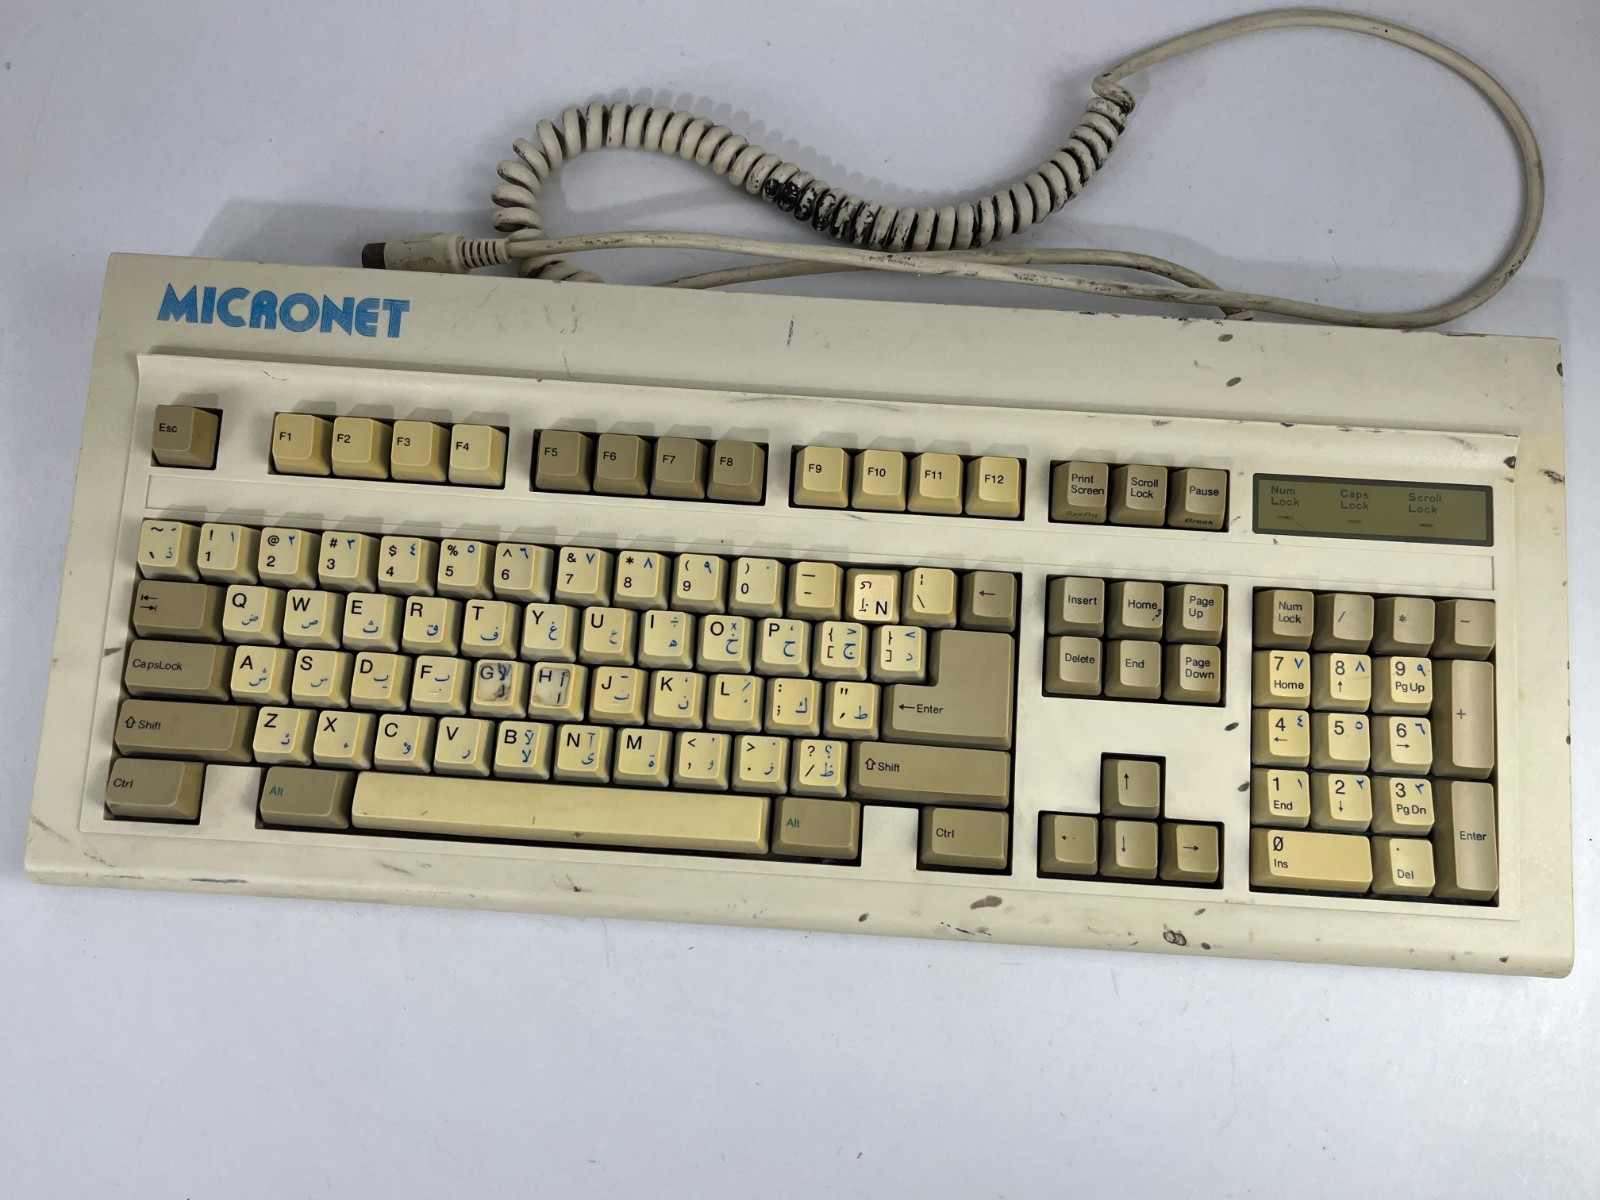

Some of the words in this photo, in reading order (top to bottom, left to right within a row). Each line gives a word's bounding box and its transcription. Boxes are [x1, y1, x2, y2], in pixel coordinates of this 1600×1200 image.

[157, 282, 410, 338] MICRONET
[159, 422, 177, 434] Esc
[279, 431, 292, 442] F1
[336, 433, 351, 444] F2
[397, 436, 410, 447] F3
[456, 441, 469, 451] F4
[544, 447, 558, 457] F5
[603, 451, 617, 461] F6
[662, 455, 676, 464] F7
[720, 457, 733, 467] F8
[808, 464, 822, 473] F9
[868, 467, 886, 477] F10
[925, 470, 942, 480] F11
[984, 474, 1004, 484] F12
[1071, 474, 1094, 484] Print
[1131, 477, 1158, 488] Scroll
[1071, 485, 1104, 495] Screen
[1131, 488, 1153, 499] Lock
[1189, 486, 1219, 496] Pause
[1271, 486, 1295, 495] Num
[1340, 489, 1369, 500] Caps
[1271, 496, 1299, 506] Lock
[1409, 493, 1442, 503] Scroll
[1341, 501, 1369, 510] Lock
[1409, 504, 1437, 514] Lock
[209, 530, 213, 540] !
[267, 535, 280, 546] @
[329, 538, 338, 548] #
[205, 551, 210, 561] 1
[388, 545, 397, 557] $
[447, 545, 458, 557] %
[266, 556, 276, 567] 2
[567, 553, 576, 563] &
[326, 559, 335, 570] 3
[386, 567, 394, 577] 4
[445, 566, 454, 577] 5
[501, 569, 510, 580] 6
[566, 574, 574, 584] 7
[623, 577, 632, 588] 8
[683, 581, 691, 591] 9
[741, 583, 749, 594] 0
[232, 593, 247, 608] Q
[292, 598, 311, 612] W
[1068, 594, 1097, 605] Insert
[1128, 600, 1158, 610] Home
[1190, 595, 1214, 607] Page
[351, 600, 363, 615] E
[410, 602, 423, 617] R
[1278, 600, 1303, 611] Num
[472, 606, 484, 620] T
[532, 610, 544, 624] Y
[1189, 608, 1203, 619] Up
[1278, 613, 1301, 624] Lock
[242, 614, 259, 625] ض
[301, 619, 319, 629] ص
[591, 613, 604, 628] U
[651, 615, 654, 629] I
[427, 624, 439, 636] ق
[481, 627, 499, 641] ف
[548, 621, 558, 641] غ
[710, 621, 724, 636] O
[769, 623, 780, 637] P
[783, 641, 796, 657] ح
[843, 643, 856, 659] ج
[240, 655, 253, 670] A
[300, 656, 313, 670] S
[1065, 653, 1095, 664] Delete
[1125, 659, 1144, 669] End
[1185, 657, 1210, 668] Page
[1274, 657, 1284, 671] 7
[132, 659, 182, 671] CapsLock
[360, 659, 373, 674] D
[1335, 661, 1345, 675] 8
[1395, 661, 1405, 676] 9
[249, 668, 267, 686] ش
[420, 665, 433, 679] F
[480, 666, 494, 680] G
[539, 670, 552, 683] H
[1185, 669, 1215, 680] Down
[311, 677, 329, 687] س
[601, 676, 612, 690] J
[660, 677, 674, 692] K
[1274, 680, 1304, 690] Home
[720, 682, 730, 696] L
[854, 706, 868, 720] ط
[916, 704, 943, 714] Enter
[138, 720, 161, 730] Shift
[264, 713, 278, 728] Z
[323, 717, 338, 732] X
[1275, 717, 1286, 731] 4
[384, 722, 399, 738] C
[446, 726, 459, 741] V
[1334, 721, 1345, 735] 5
[1396, 723, 1407, 737] 6
[504, 729, 517, 744] B
[567, 732, 580, 748] N
[626, 735, 642, 750] M
[808, 745, 816, 757] ?
[820, 762, 834, 777] ظ
[878, 763, 900, 773] Shift
[113, 778, 134, 789] Ctrl
[1273, 777, 1280, 791] 1
[1335, 780, 1345, 794] 2
[269, 786, 283, 796] Alt
[1395, 783, 1406, 797] 3
[1274, 801, 1293, 811] End
[787, 818, 800, 828] Alt
[936, 828, 955, 838] Ctrl
[1460, 831, 1487, 841] Enter
[1274, 859, 1288, 869] Ins
[1397, 869, 1414, 879] Del
